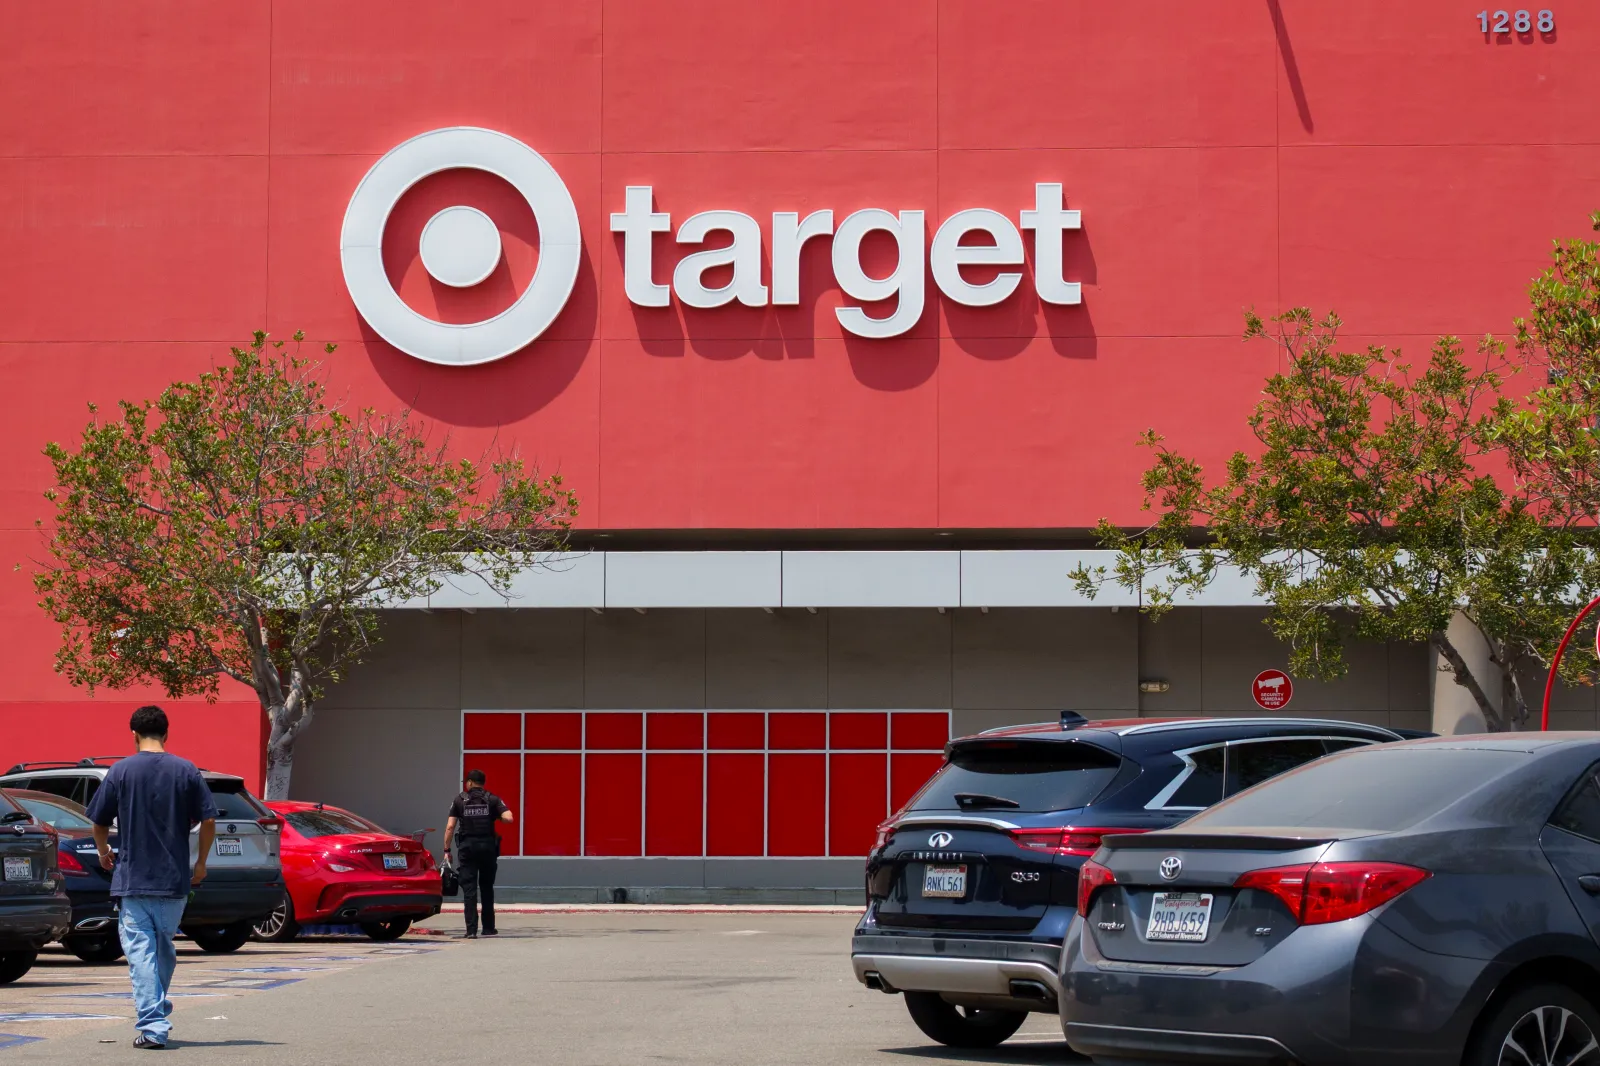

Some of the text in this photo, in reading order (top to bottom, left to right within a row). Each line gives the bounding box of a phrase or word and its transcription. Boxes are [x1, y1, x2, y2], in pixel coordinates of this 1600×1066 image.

[1476, 9, 1554, 33] 1288
[609, 182, 1082, 339] target
[913, 852, 963, 860] INFINITI
[926, 877, 963, 892] 8NKL561
[1152, 910, 1206, 933] 9HBJ659
